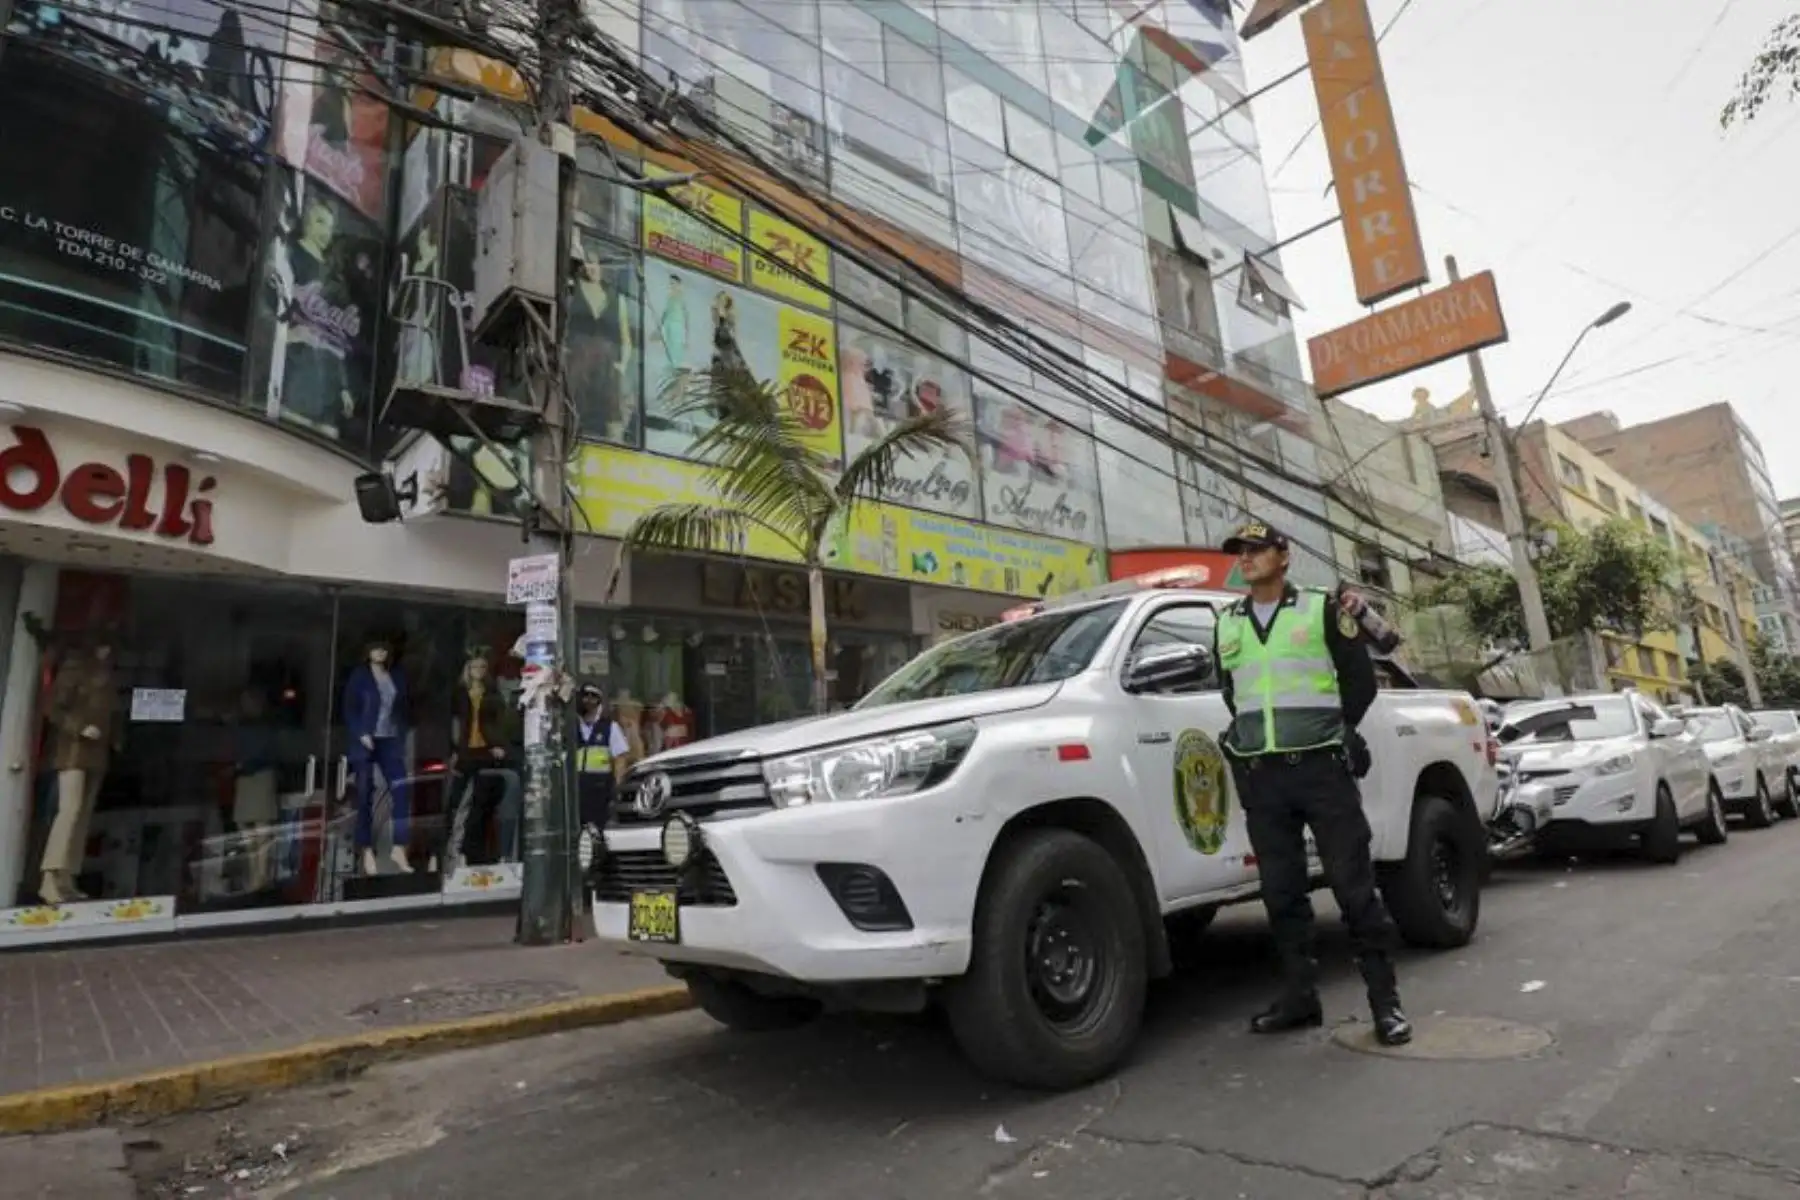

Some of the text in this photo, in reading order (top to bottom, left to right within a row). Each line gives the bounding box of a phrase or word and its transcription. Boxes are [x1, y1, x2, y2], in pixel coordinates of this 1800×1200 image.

[24, 212, 49, 232] LA
[54, 221, 115, 249] TORRE
[118, 242, 145, 262] DE
[146, 252, 223, 292] GAMARRA
[56, 237, 93, 260] TDA
[95, 251, 126, 271] 210
[138, 264, 168, 285] 322
[763, 229, 818, 275] ZK
[1350, 282, 1490, 352] GAMARRA
[787, 327, 828, 361] ZK
